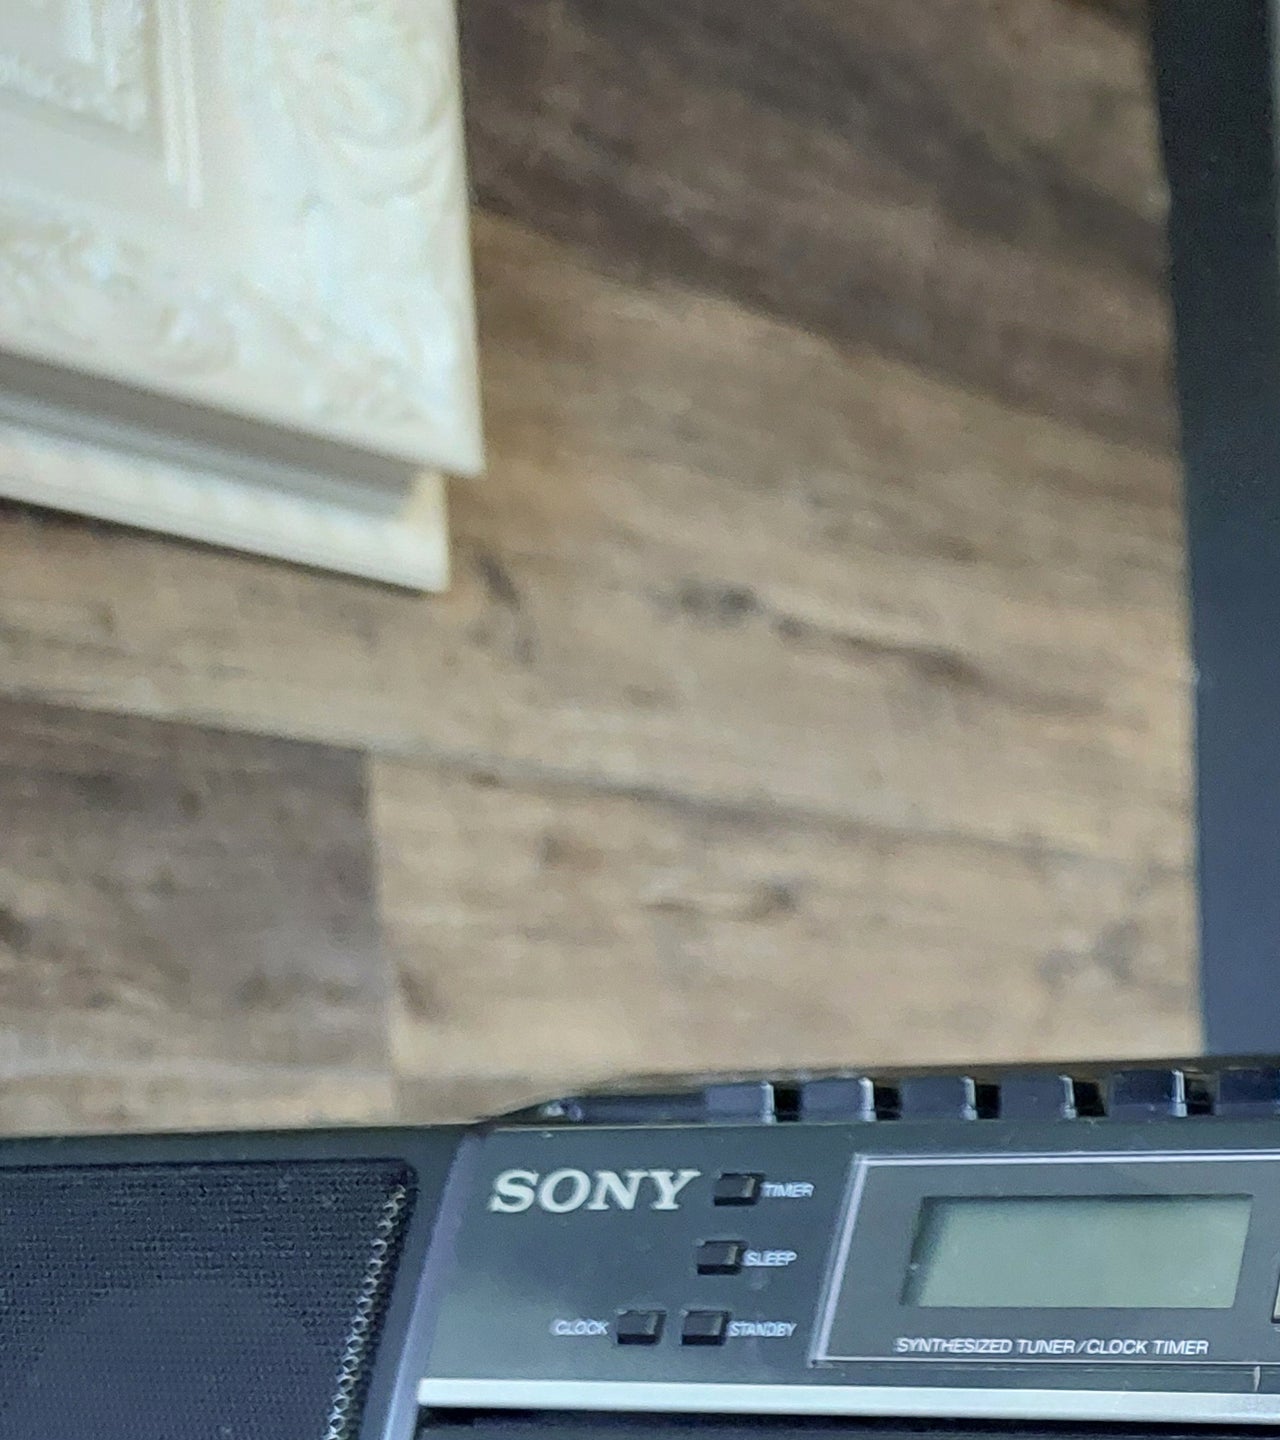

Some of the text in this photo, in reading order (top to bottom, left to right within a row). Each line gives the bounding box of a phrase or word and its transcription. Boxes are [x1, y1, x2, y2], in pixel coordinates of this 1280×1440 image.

[489, 1168, 701, 1213] SONY
[761, 1181, 815, 1199] TIMER
[743, 1250, 798, 1267] SLEEP
[551, 1319, 609, 1337] CLOCK
[728, 1320, 797, 1338] STANDBY
[896, 1337, 1209, 1355] SYNTHESIZED TUNER/CLOCK TIMER
